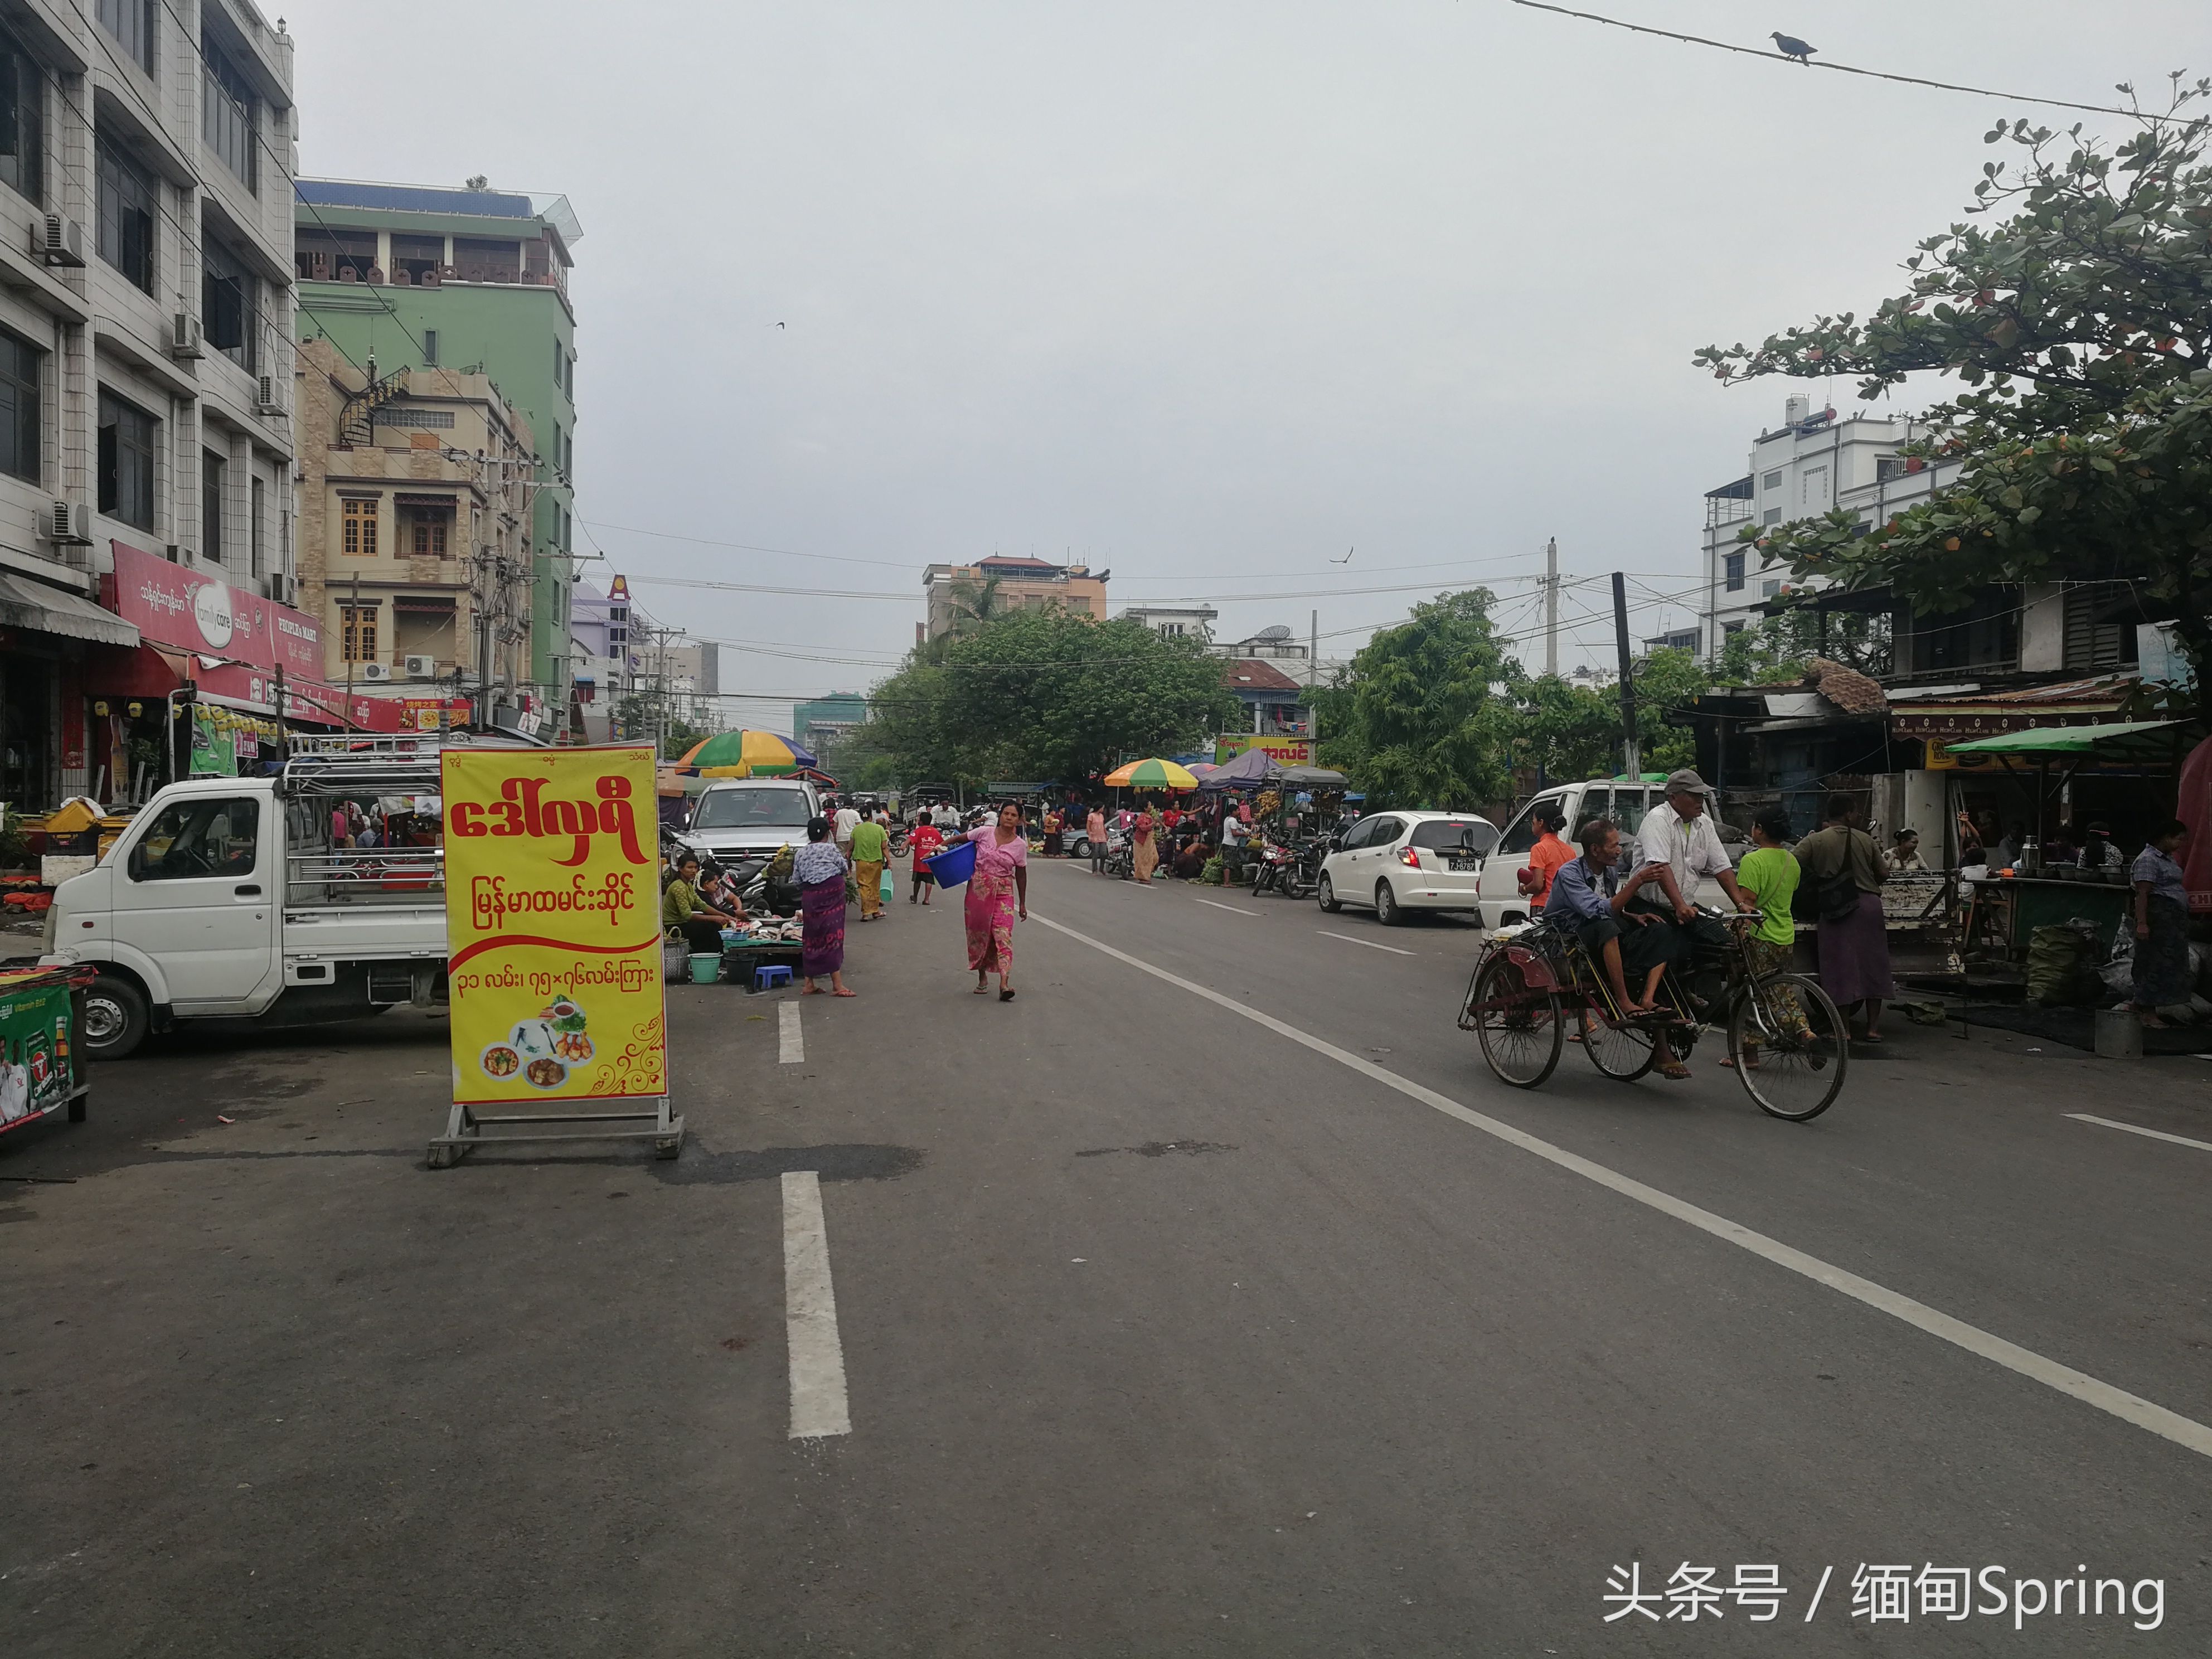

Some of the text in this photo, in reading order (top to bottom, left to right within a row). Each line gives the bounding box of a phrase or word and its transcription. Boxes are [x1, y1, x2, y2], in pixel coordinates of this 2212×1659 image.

[302, 626, 317, 642] MART
[471, 872, 634, 930] မြန်မာထမင်းဆိုင်
